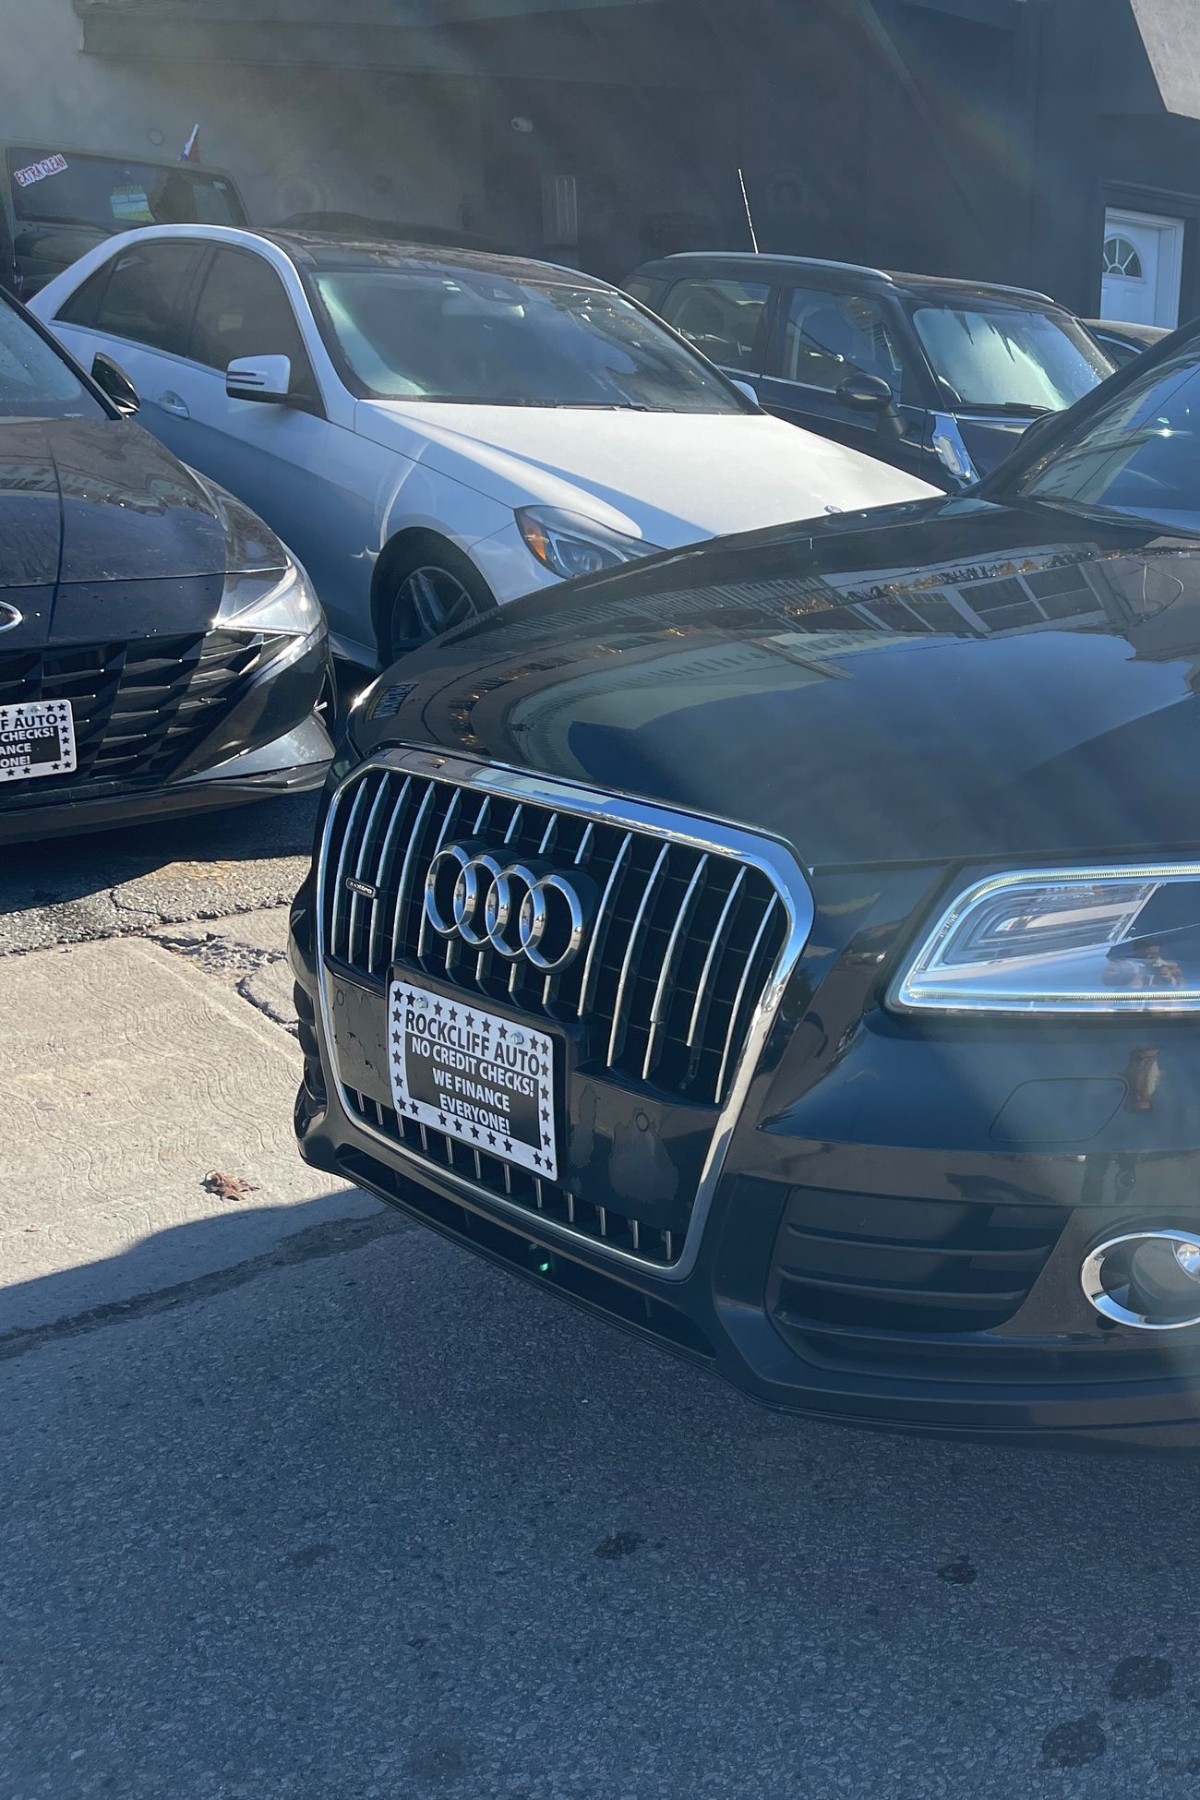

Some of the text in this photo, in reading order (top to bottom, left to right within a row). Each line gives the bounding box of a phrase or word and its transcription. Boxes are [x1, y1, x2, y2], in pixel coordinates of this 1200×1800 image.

[0, 727, 55, 743] CHECKS!
[15, 713, 58, 729] AUTO
[405, 1009, 540, 1077] ROCKCLIFF AUTO
[411, 1036, 534, 1098] NO CREDIT CHECKS!
[432, 1067, 511, 1112] WE FINANCE
[439, 1092, 511, 1136] EVERYONE!
